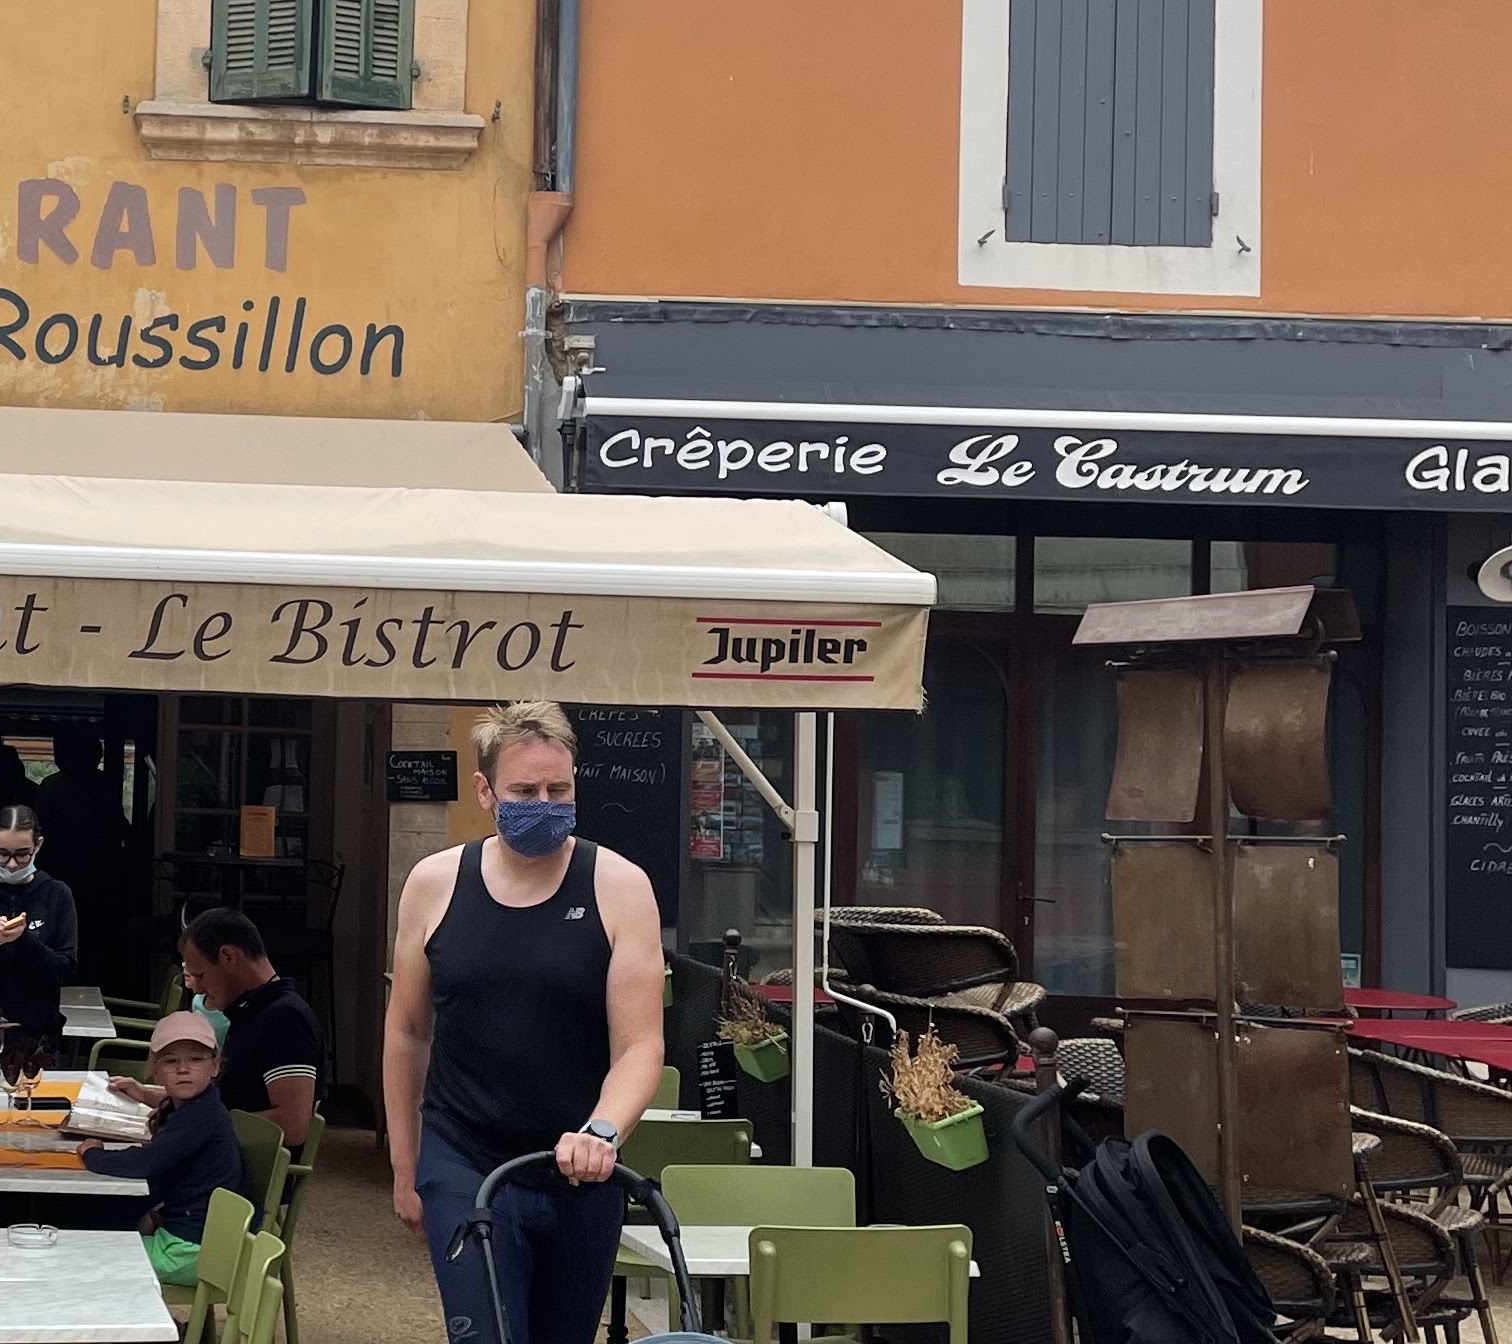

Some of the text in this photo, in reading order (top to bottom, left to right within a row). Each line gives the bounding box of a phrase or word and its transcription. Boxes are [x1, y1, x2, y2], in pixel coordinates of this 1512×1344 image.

[600, 428, 1510, 496] Crêperie Le Castrum Gla
[129, 592, 233, 661] Le
[269, 595, 584, 672] Bistrot
[702, 627, 868, 673] Jupiler
